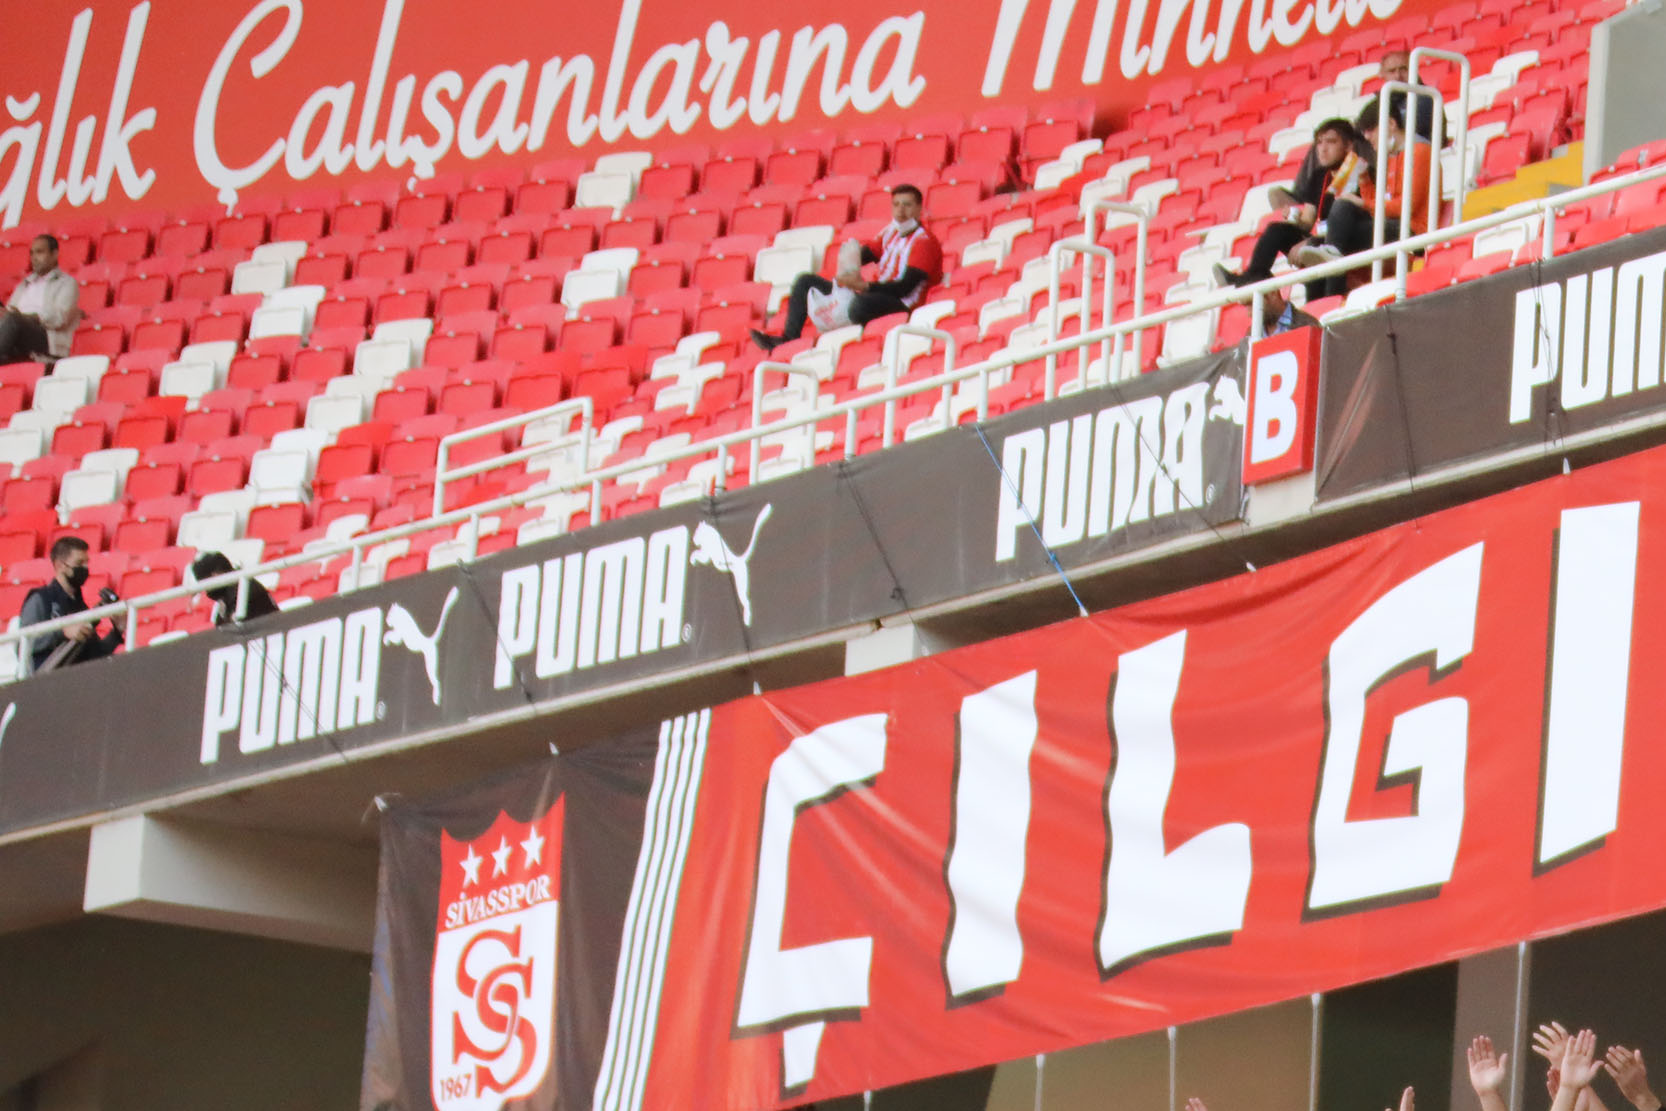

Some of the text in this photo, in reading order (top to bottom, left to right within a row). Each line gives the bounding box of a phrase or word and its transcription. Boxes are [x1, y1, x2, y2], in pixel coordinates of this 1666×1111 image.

[995, 383, 1207, 561] PUMA
[1250, 349, 1300, 465] B
[200, 607, 381, 764] PUMA
[494, 526, 688, 690] PUMA
[440, 1073, 472, 1102] 1967
